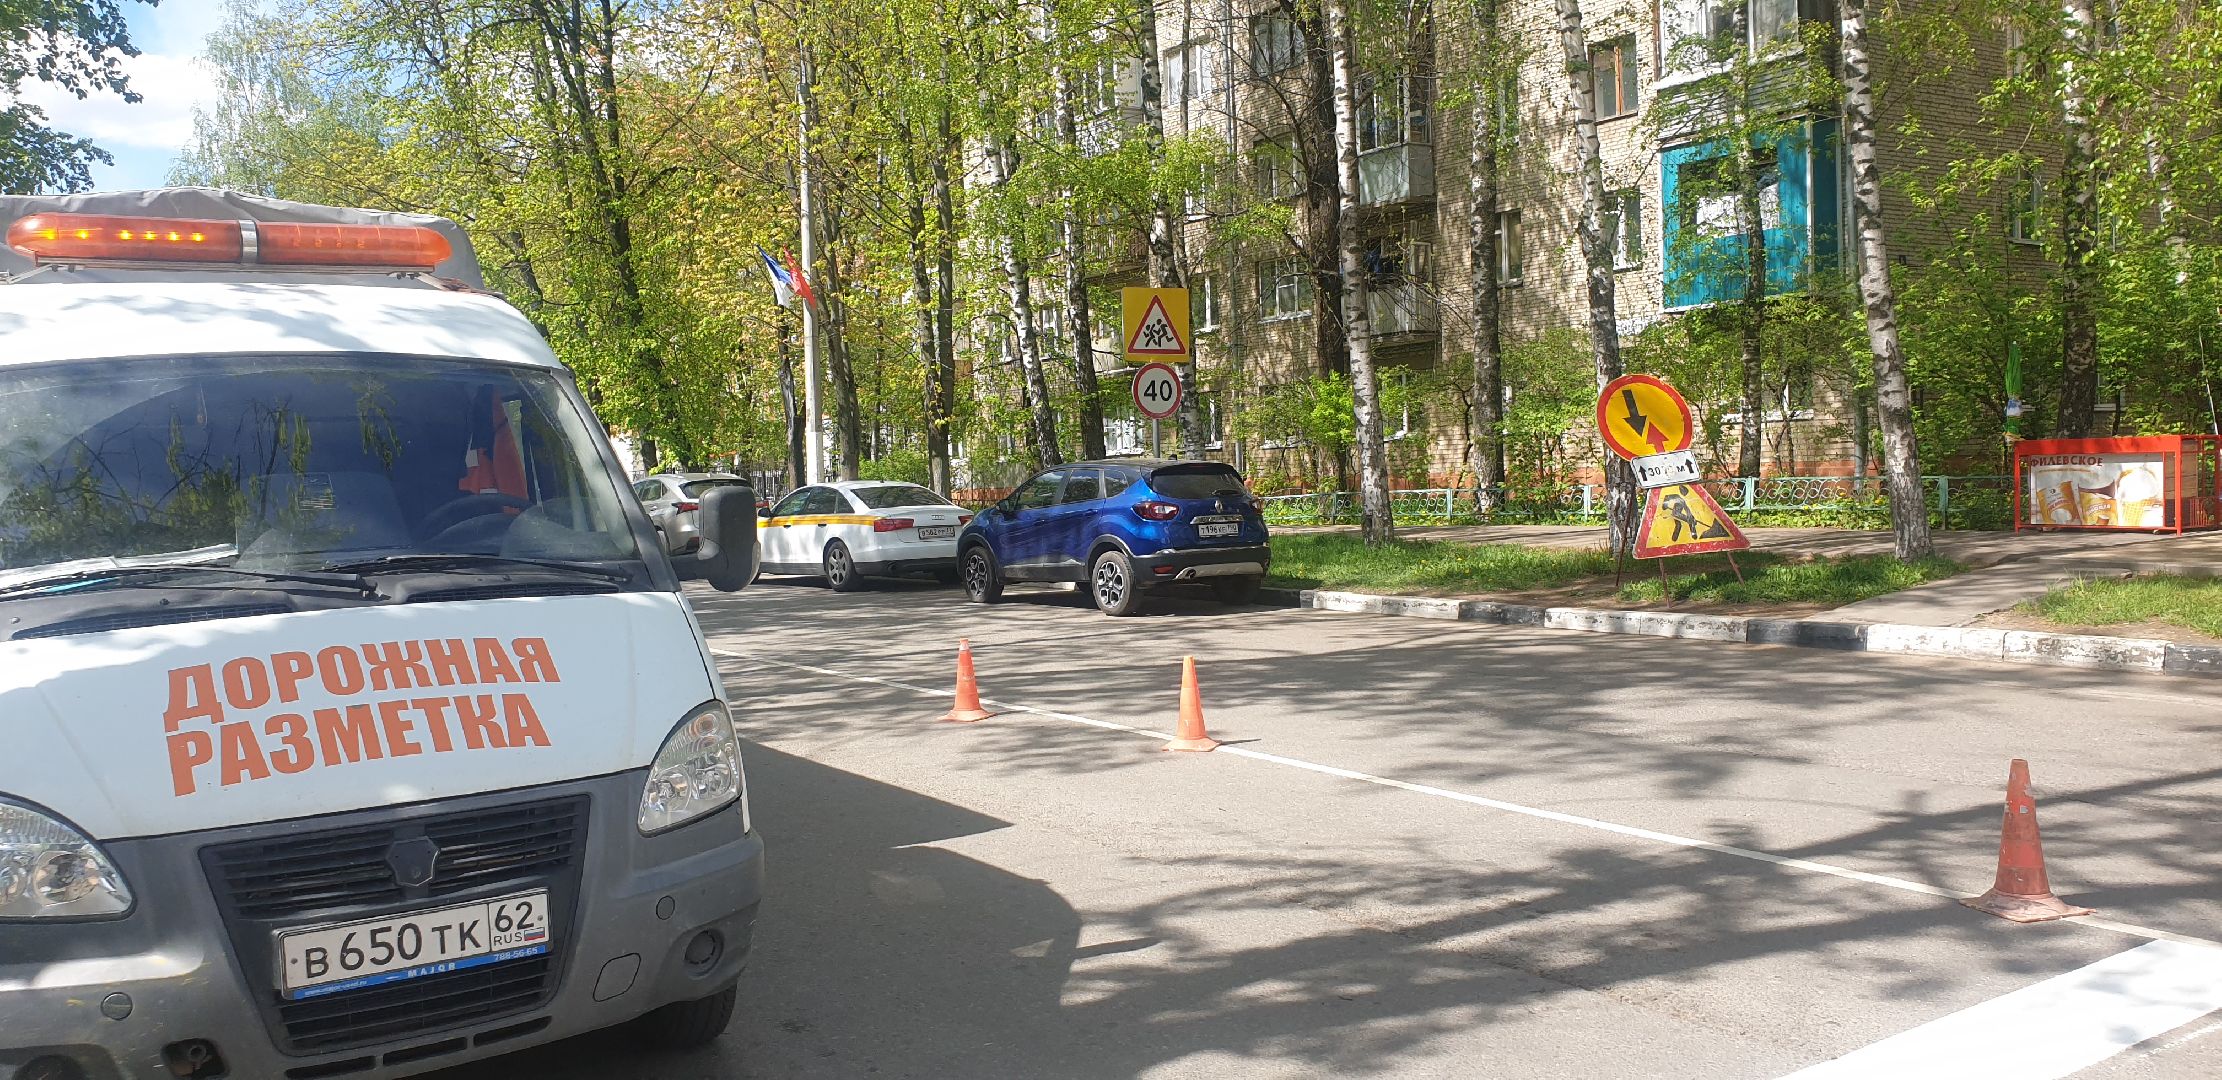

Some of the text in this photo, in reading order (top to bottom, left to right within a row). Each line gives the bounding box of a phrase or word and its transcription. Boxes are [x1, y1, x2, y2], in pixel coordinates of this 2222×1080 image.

[1143, 379, 1173, 402] 40
[2031, 455, 2104, 467] ФИЛЕВСКОЕ
[163, 637, 561, 733] ДОРОЖНАЯ
[166, 693, 552, 797] РАЗМЕТКА
[494, 901, 535, 933] 62
[493, 931, 523, 947] RUS
